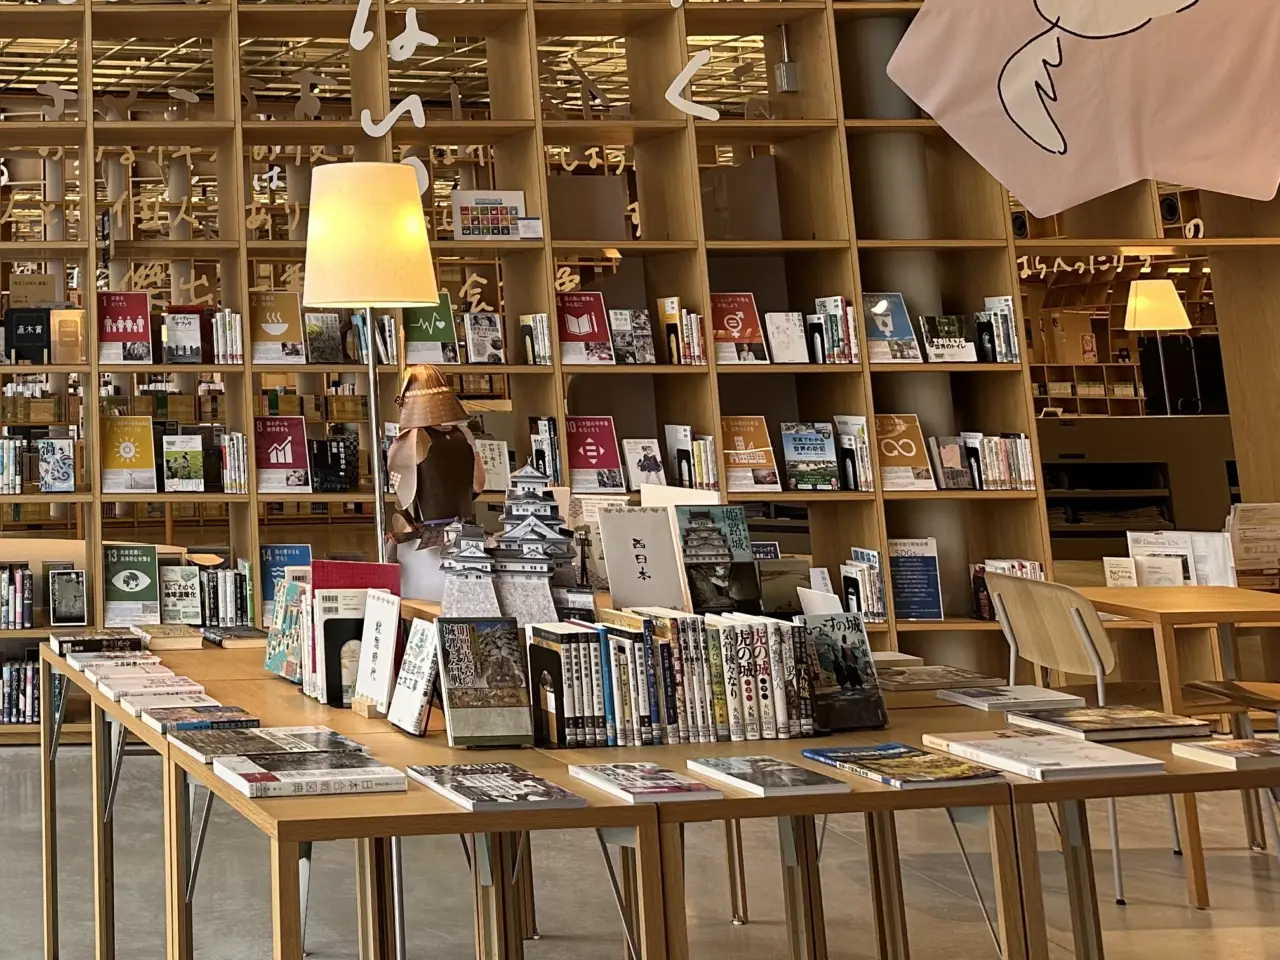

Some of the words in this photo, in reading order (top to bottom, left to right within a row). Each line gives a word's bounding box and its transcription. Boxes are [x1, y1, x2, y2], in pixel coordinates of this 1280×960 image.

[16, 324, 43, 335] 直木賞
[725, 507, 746, 552] 姫路城
[107, 549, 117, 562] 13
[261, 549, 272, 561] 14
[632, 538, 651, 581] 西日本
[736, 629, 754, 678] 虎の城
[753, 628, 770, 676] 虎の城
[292, 779, 373, 793] 日本合戦図典
